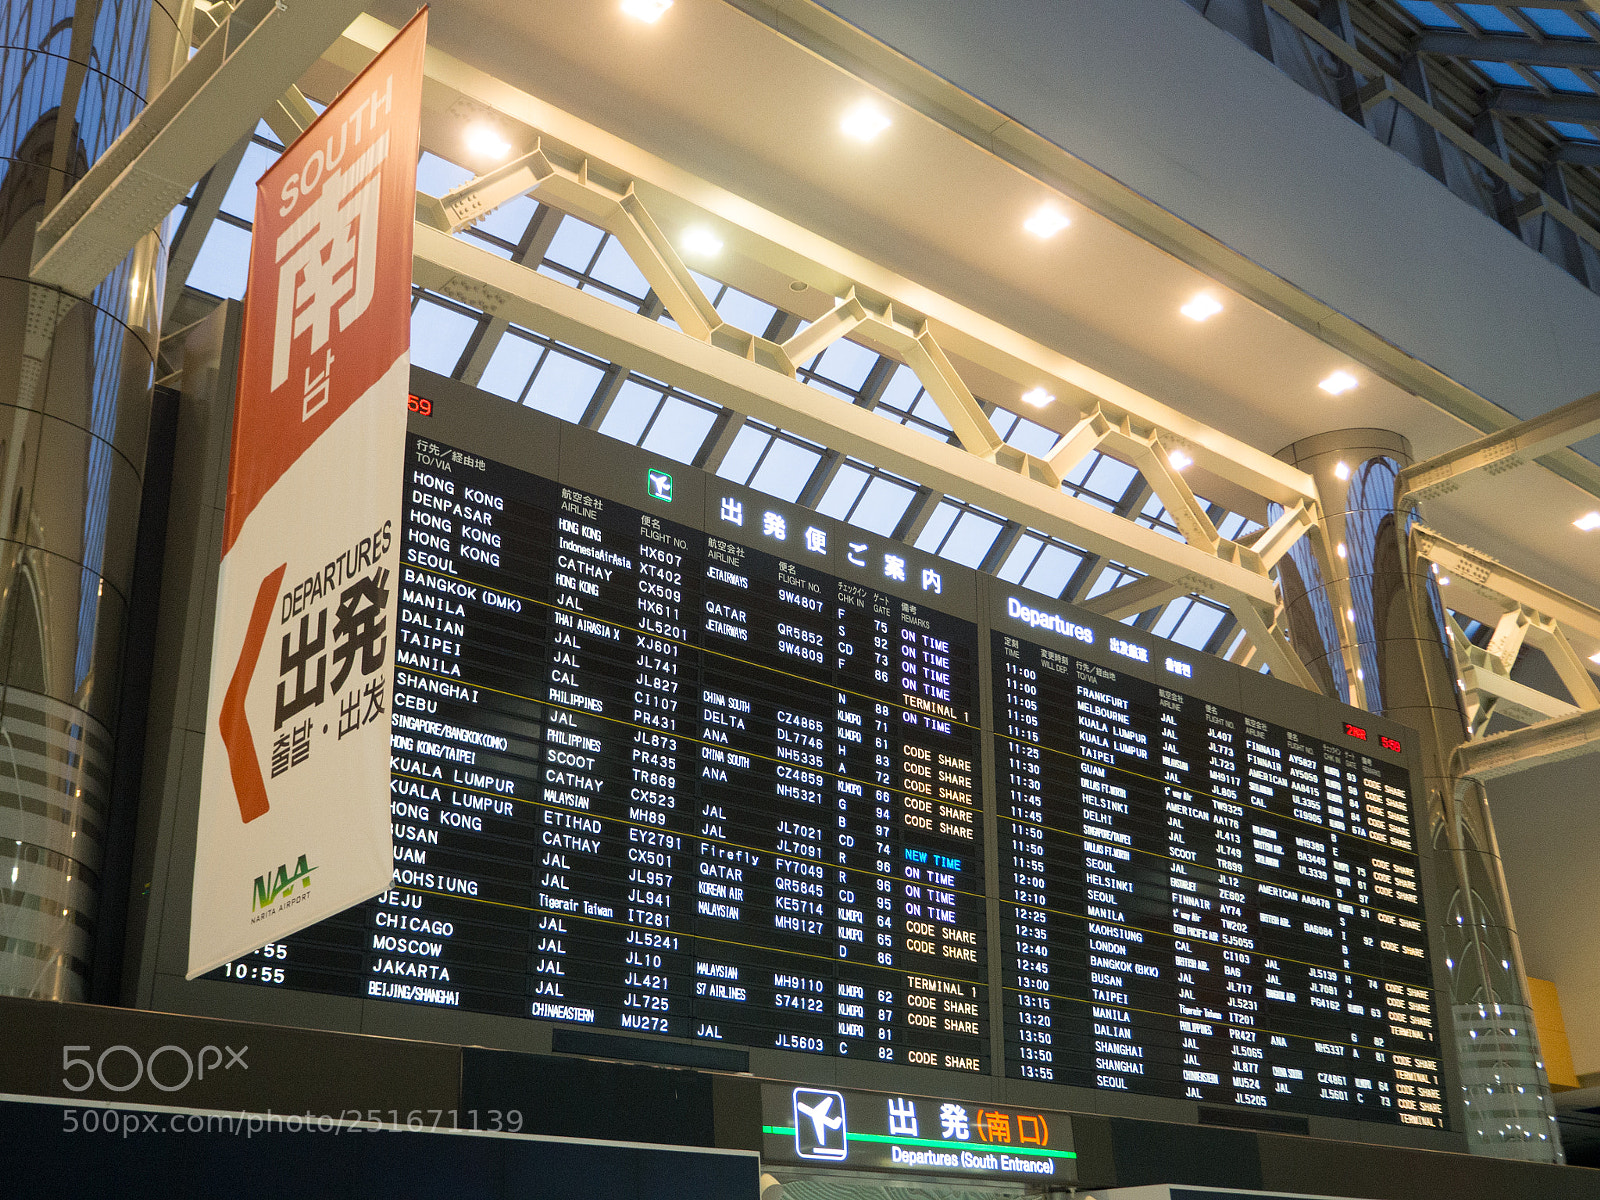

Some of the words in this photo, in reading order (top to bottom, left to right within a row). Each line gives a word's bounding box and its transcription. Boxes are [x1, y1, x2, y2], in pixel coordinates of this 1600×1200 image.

[279, 73, 393, 218] SOUTH
[270, 129, 390, 393] 南
[302, 348, 335, 423] 남
[416, 439, 486, 471] 行先／経由地
[416, 452, 452, 472] TO/VIA
[414, 471, 455, 495] HONG
[464, 488, 504, 511] KONG
[562, 488, 603, 511] 航空会社
[413, 490, 492, 526] DENPASAR
[561, 501, 597, 520] AIRLINE
[410, 510, 451, 533] HONG
[462, 526, 501, 548] KONG
[641, 515, 661, 530] 便名
[640, 526, 672, 545] FLIGHT
[673, 536, 689, 551] NO.
[407, 549, 458, 575] SEOUL
[559, 537, 631, 570] IndonesiaAirAsia
[640, 544, 683, 567] HX607
[281, 519, 392, 625] DEPARTURES
[558, 555, 613, 581] CATHAY
[639, 562, 682, 586] XT402
[405, 569, 476, 600] BANGKOK
[483, 590, 522, 613] (DMK)
[638, 581, 681, 603] CX509
[778, 589, 823, 613] 9W4807
[837, 592, 854, 604] CHK
[855, 598, 864, 608] IN
[402, 589, 466, 618] MANILA
[557, 594, 583, 611] JAL
[706, 601, 747, 623] QATAR
[873, 604, 891, 617] GATE
[901, 603, 917, 615] 備考
[401, 609, 464, 636] DALIAN
[638, 617, 687, 640] JL5201
[874, 620, 888, 634] 75
[901, 613, 930, 630] REMARKS
[1008, 597, 1094, 644] Departures
[400, 629, 462, 656] TAIPEI
[777, 624, 823, 646] QR5852
[901, 629, 916, 643] ON
[922, 634, 949, 653] TIME
[274, 566, 390, 732] 出発
[637, 635, 678, 657] XJ601
[1005, 648, 1020, 659] TIME
[398, 649, 461, 677] MANILA
[1006, 663, 1036, 680] 11:00
[397, 672, 479, 703] SHANGHAI
[636, 674, 679, 694] JL827
[337, 673, 386, 741] 出发
[394, 692, 438, 713] CEBU
[549, 688, 603, 712] PHILIPPINES
[903, 694, 957, 719] TERMINAL
[964, 711, 969, 722] 1
[1077, 686, 1129, 710] FRANKFURT
[634, 710, 676, 731] PR431
[703, 709, 746, 730] DELTA
[1077, 701, 1130, 725] MELBOURNE
[391, 713, 508, 751] SINGAPORE/BANGKOK(DMK)
[703, 728, 728, 744] ANA
[777, 728, 823, 750] DL7746
[1079, 716, 1108, 732] KUALA
[1112, 726, 1147, 744] LUMPUR
[1208, 728, 1233, 743] JL407
[271, 717, 313, 779] 출발
[390, 734, 413, 754] HONG
[416, 740, 476, 765] KONG/TAIPEI
[903, 745, 931, 760] CODE
[938, 754, 972, 771] SHARE
[1008, 742, 1040, 759] 11:25
[1246, 740, 1281, 758] FINNAIR
[547, 750, 596, 770] SCOOT
[1081, 763, 1105, 777] GUAM
[1210, 757, 1235, 771] JL723
[389, 756, 443, 779] KUALA
[454, 769, 515, 794] LUMPUR
[632, 768, 676, 789] TR869
[630, 788, 676, 809] CX523
[1010, 790, 1042, 807] 11:45
[1363, 778, 1382, 791] CODE
[1384, 785, 1406, 799] SHARE
[875, 808, 890, 820] 94
[1082, 793, 1129, 814] HELSINKI
[1166, 802, 1209, 821] AMERICAN
[544, 810, 602, 833] ETIHAD
[1083, 809, 1112, 825] DELHI
[629, 827, 682, 850] EY2791
[776, 820, 822, 841] JL7021
[701, 843, 759, 866] Firefly
[905, 848, 928, 864] NEW
[933, 855, 961, 871] TIME
[776, 858, 823, 879] FY7049
[1085, 858, 1115, 873] SEOUL
[253, 854, 319, 913] NAA
[698, 880, 726, 898] KOREAN
[729, 887, 743, 901] AIR
[250, 909, 276, 925] NARITA
[279, 891, 311, 911] AIRPORT
[378, 890, 423, 909] JEJU
[539, 893, 579, 912] Tigerair
[583, 900, 613, 918] Taiwan
[775, 896, 824, 916] KE5714
[1014, 890, 1046, 905] 12:10
[1172, 893, 1210, 910] FINNAIR
[376, 912, 454, 936] CHICAGO
[1221, 919, 1248, 933] TW202
[373, 934, 442, 957] MOSCOW
[1016, 942, 1048, 956] 12:40
[1090, 939, 1127, 955] LONDON
[373, 958, 450, 982] JAKARTA
[625, 951, 662, 968] JL10
[1090, 956, 1132, 973] BANGKOK
[1134, 964, 1159, 977] (BKK)
[225, 962, 285, 984] 10:55
[368, 980, 460, 1006] BEIJING/SHANGHAI
[696, 983, 707, 996] S7
[709, 984, 746, 1000] AIRLINES
[907, 976, 964, 996] TERMINAL
[971, 987, 977, 998] 1
[531, 1002, 595, 1023] CHINAEASTERN
[624, 993, 669, 1011] JL725
[775, 994, 823, 1012] S74122
[621, 1014, 669, 1033] MU272
[1094, 1024, 1131, 1039] DALIAN
[776, 1034, 823, 1051] JL5603
[1229, 1029, 1256, 1042] PR427
[878, 1047, 893, 1060] 82
[908, 1051, 937, 1066] CODE
[945, 1056, 980, 1071] SHARE
[1231, 1045, 1263, 1059] JL5065
[1020, 1065, 1053, 1080] 13:55
[1096, 1058, 1144, 1074] SHANGHAI
[891, 1146, 959, 1167] Departures
[961, 1153, 998, 1170] (South
[1000, 1158, 1054, 1174] Entrance)
